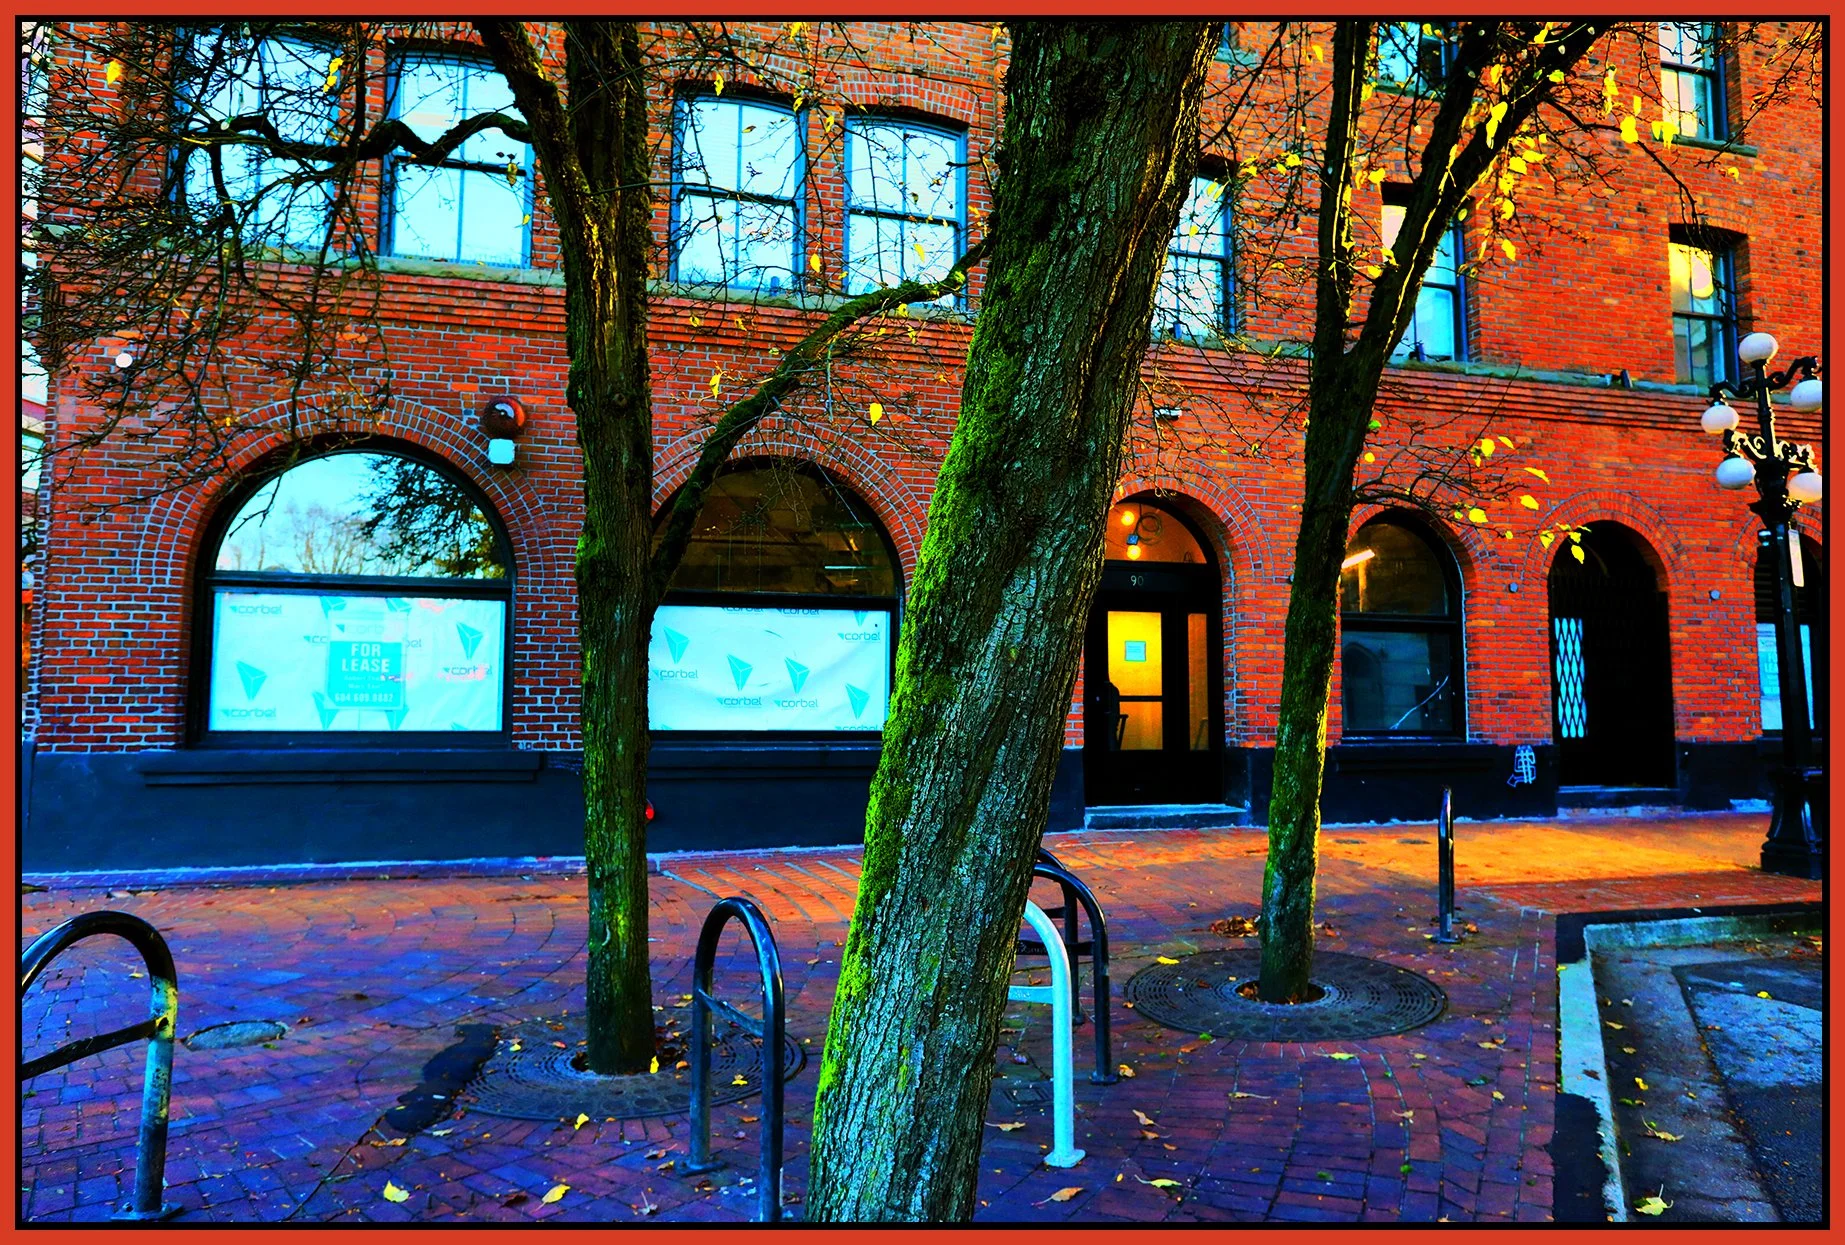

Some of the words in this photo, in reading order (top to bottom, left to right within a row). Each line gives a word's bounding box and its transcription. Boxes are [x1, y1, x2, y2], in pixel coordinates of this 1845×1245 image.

[1130, 575, 1144, 587] 90
[238, 604, 282, 615] corbel
[844, 632, 881, 641] corbel
[351, 643, 381, 656] FOR
[341, 658, 390, 673] LEASE
[660, 669, 699, 679] corbel
[723, 696, 762, 706] corbel
[781, 698, 818, 708] corbel
[231, 707, 277, 718] corbel
